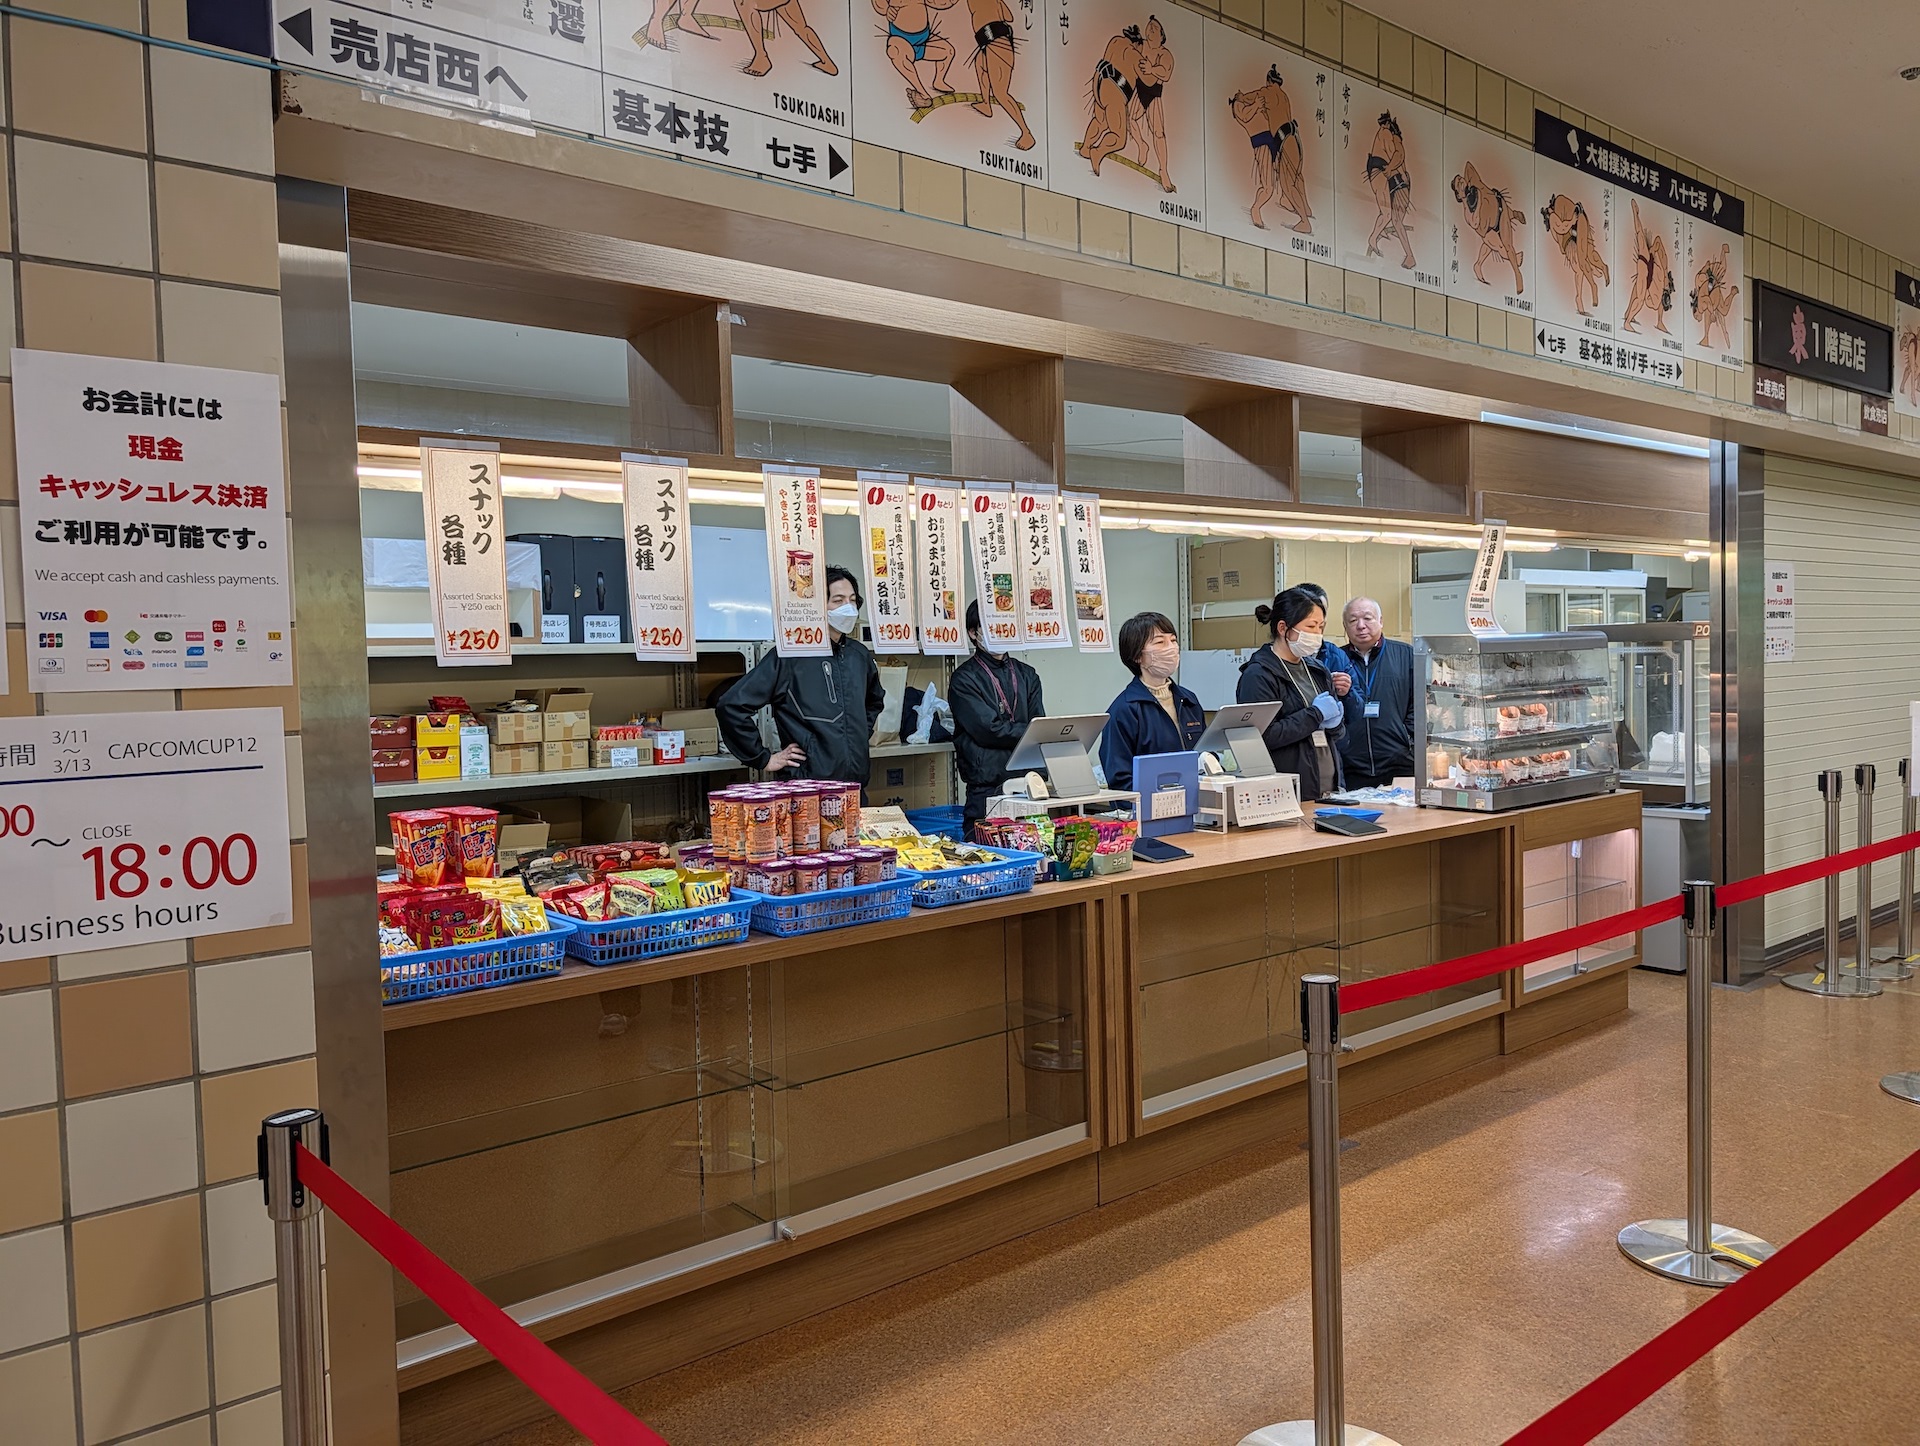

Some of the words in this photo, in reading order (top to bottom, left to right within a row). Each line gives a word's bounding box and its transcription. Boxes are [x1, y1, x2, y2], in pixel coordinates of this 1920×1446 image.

[329, 18, 528, 102] 売店西へ
[773, 92, 845, 127] TSUKIDASHI
[1315, 72, 1327, 139] 押し倒し
[612, 88, 730, 156] 基本技
[766, 137, 817, 174] 七手
[980, 150, 1043, 180] TSUKITAOSHI
[1586, 142, 1660, 192] 大相撲決まり手
[1668, 178, 1708, 212] 八十七手
[1159, 200, 1202, 223] OSHIDASHI
[1291, 236, 1332, 259] OSHITAOSHI
[1414, 270, 1441, 288] YORIKIRI
[1547, 334, 1566, 354] 七手
[1579, 337, 1613, 366] 基本技
[1616, 346, 1649, 374] 投げ手
[1651, 360, 1673, 379] 十三手
[1756, 377, 1786, 401] 土産売店
[83, 387, 223, 420] お会計には
[128, 434, 184, 462] 現金
[39, 474, 268, 509] キャッシュレス決済
[886, 494, 904, 502] なとり
[469, 463, 494, 555] スナック
[779, 489, 791, 542] やきとり味
[791, 480, 803, 546] チップスター
[937, 501, 954, 509] なとり
[990, 502, 1007, 510] なとり
[1035, 502, 1051, 510] なとり
[656, 479, 677, 562] スナック
[35, 519, 268, 550] ご利用が可能です。
[441, 514, 467, 566] 各種
[987, 518, 998, 562] うずらの
[1028, 516, 1041, 566] 牛タン
[1040, 514, 1051, 556] おつまみ
[634, 524, 655, 571] 各種
[34, 569, 59, 582] We
[61, 572, 105, 584] accept
[108, 571, 137, 583] cash
[140, 571, 164, 583] and
[166, 572, 216, 585] cashless
[218, 574, 279, 587] payments.
[889, 538, 899, 616] ゴールドシリーズ
[927, 517, 942, 617] おつまみセット
[980, 536, 993, 604] 味付けたまご
[442, 592, 474, 601] Assorted
[476, 592, 503, 601] Snacks
[460, 602, 483, 611] ¥250
[484, 603, 502, 611] each
[635, 593, 661, 601] Assorted
[662, 593, 685, 602] Snacks
[650, 602, 668, 611] ¥250
[669, 603, 684, 611] each
[877, 581, 891, 616] 各種
[38, 611, 68, 621] VISA
[446, 628, 500, 650] ¥250
[640, 627, 683, 647] ¥250
[784, 626, 823, 645] ¥250
[878, 623, 910, 640] ¥350
[925, 626, 958, 643] ¥400
[988, 623, 1016, 638] ¥450
[1027, 621, 1060, 637] ¥450
[1081, 627, 1104, 643] ¥500
[52, 730, 89, 744] 3/11
[107, 736, 258, 761] CAPCOMCUP12
[53, 758, 91, 773] 3/13
[821, 799, 841, 810] chip
[821, 807, 841, 816] star
[82, 824, 133, 841] CLOSE
[82, 833, 258, 901] 18:00
[692, 884, 723, 903] RITZ
[134, 901, 219, 929] hours
